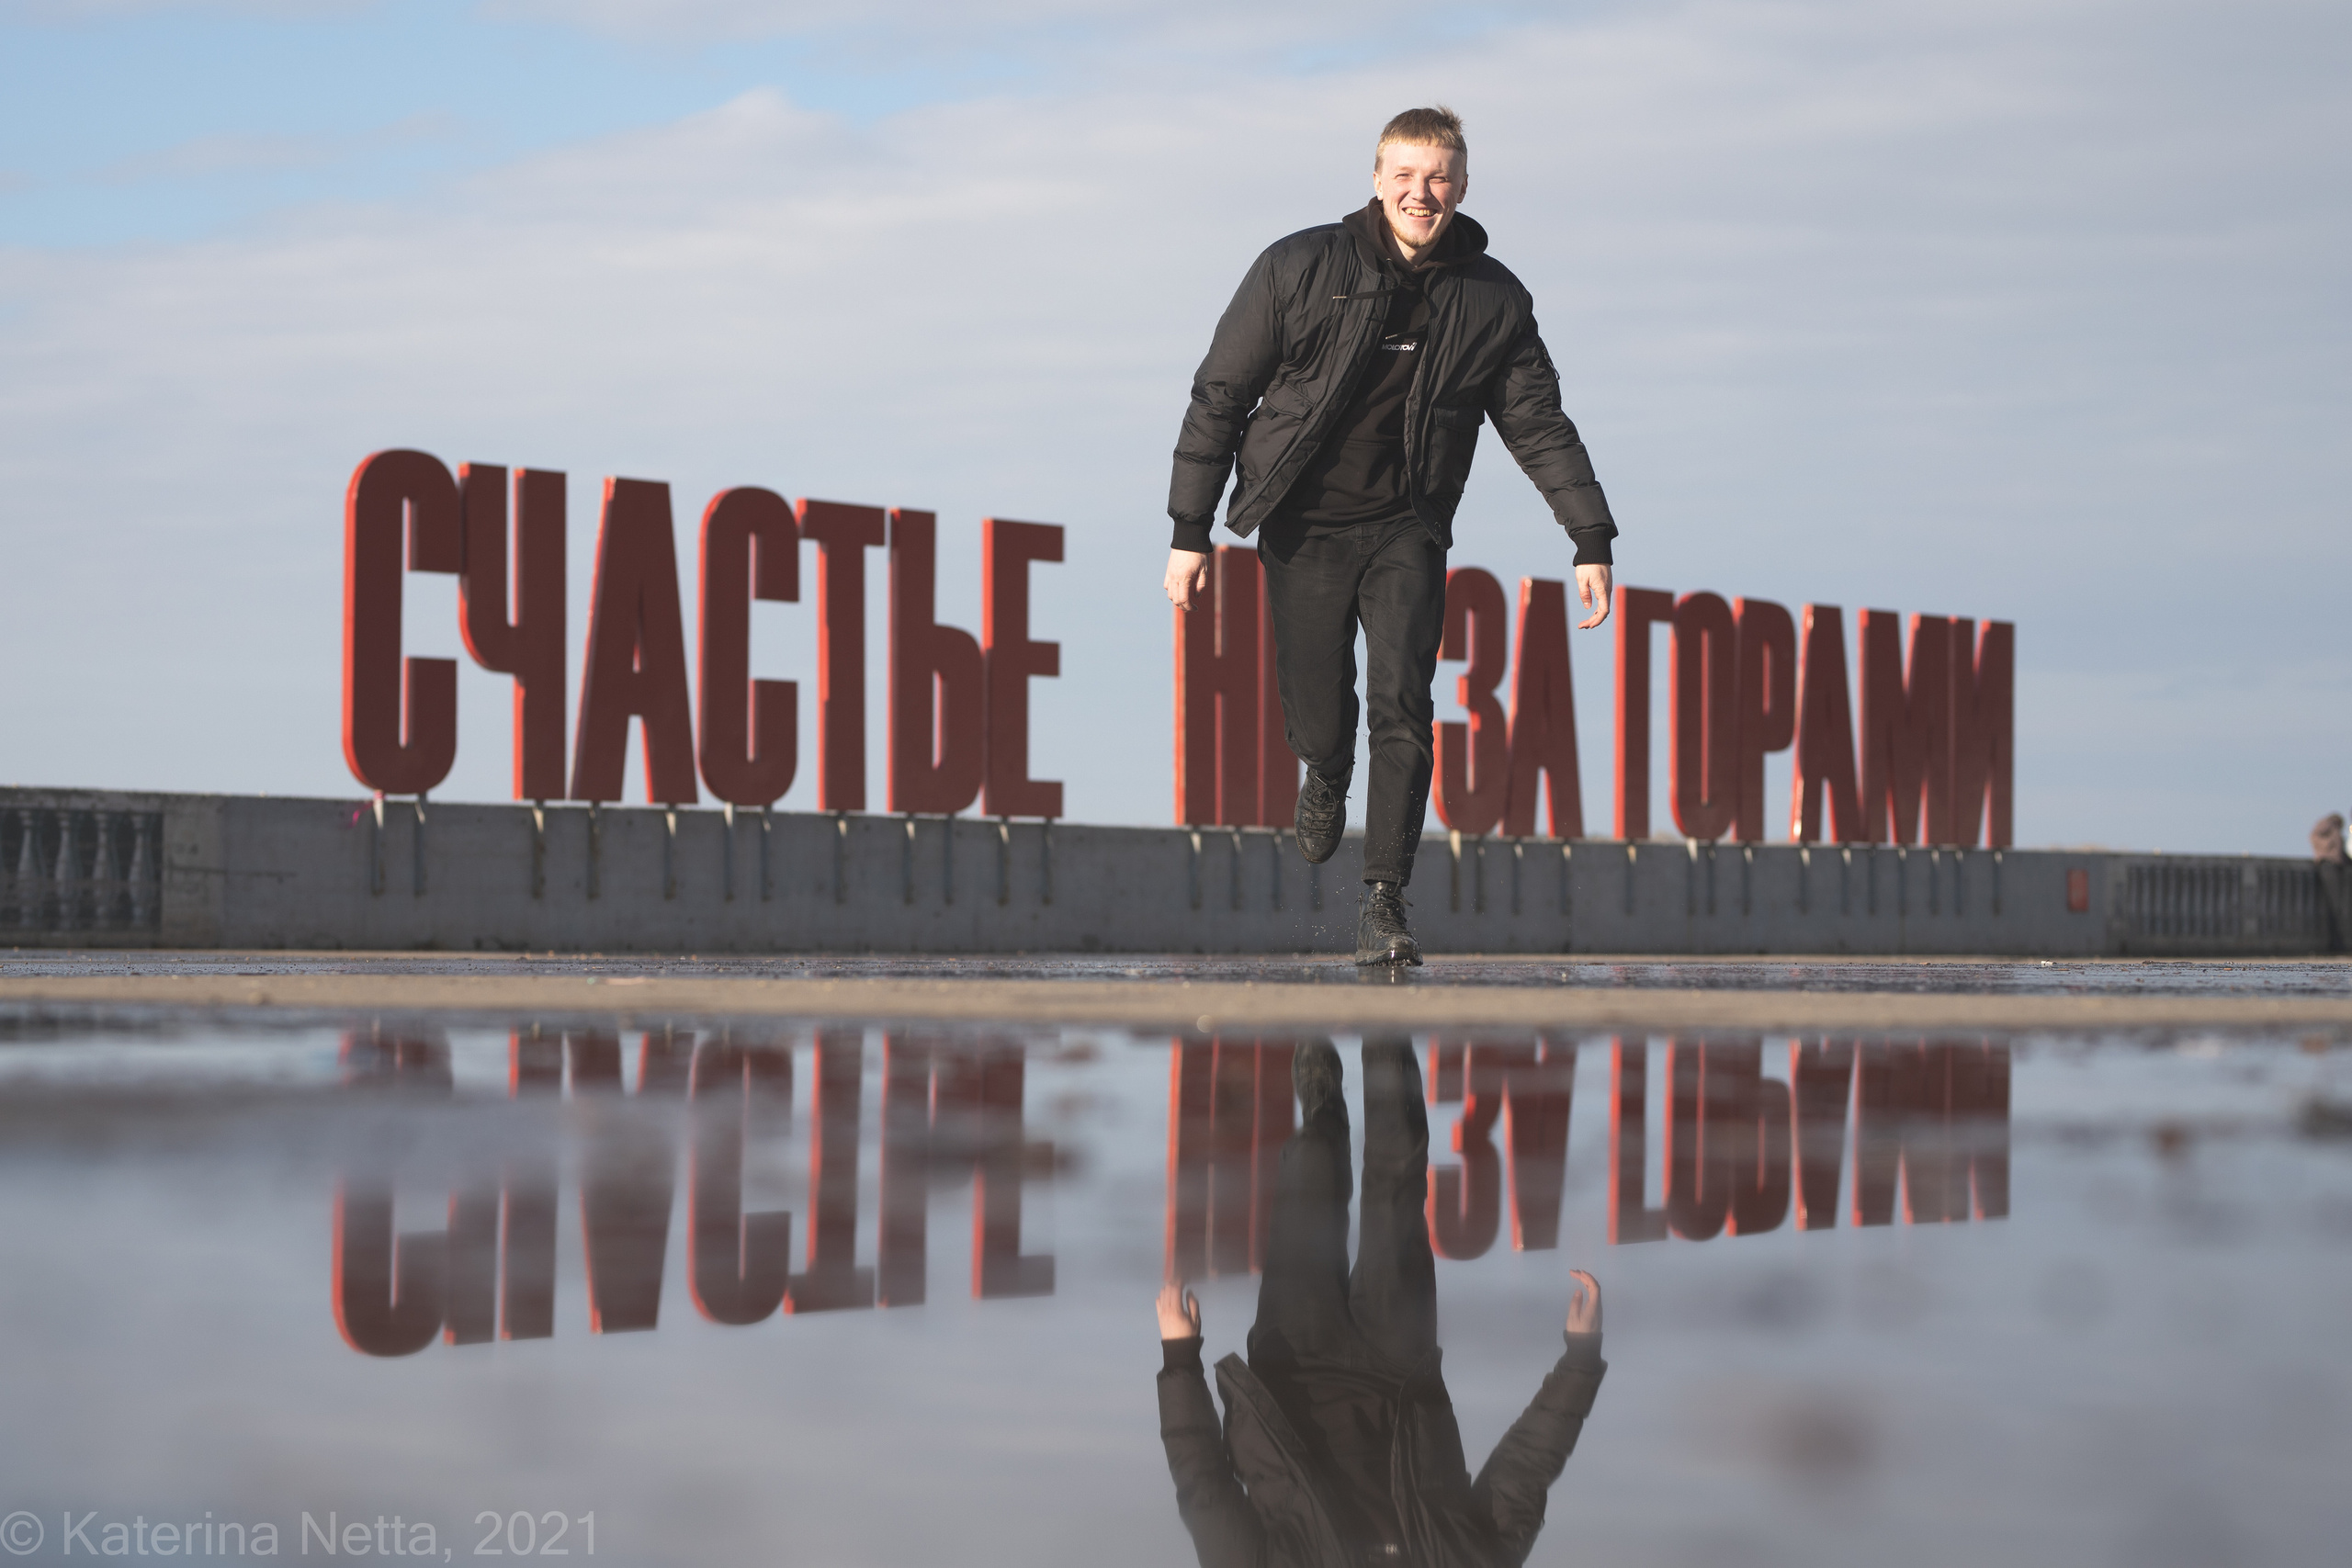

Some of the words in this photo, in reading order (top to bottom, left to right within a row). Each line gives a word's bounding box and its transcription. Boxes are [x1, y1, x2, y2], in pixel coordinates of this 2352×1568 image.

[343, 448, 1065, 818] СЧАСТЬЕ
[1430, 567, 1584, 838] ЗА
[1614, 584, 2016, 848] ГОРАМИ
